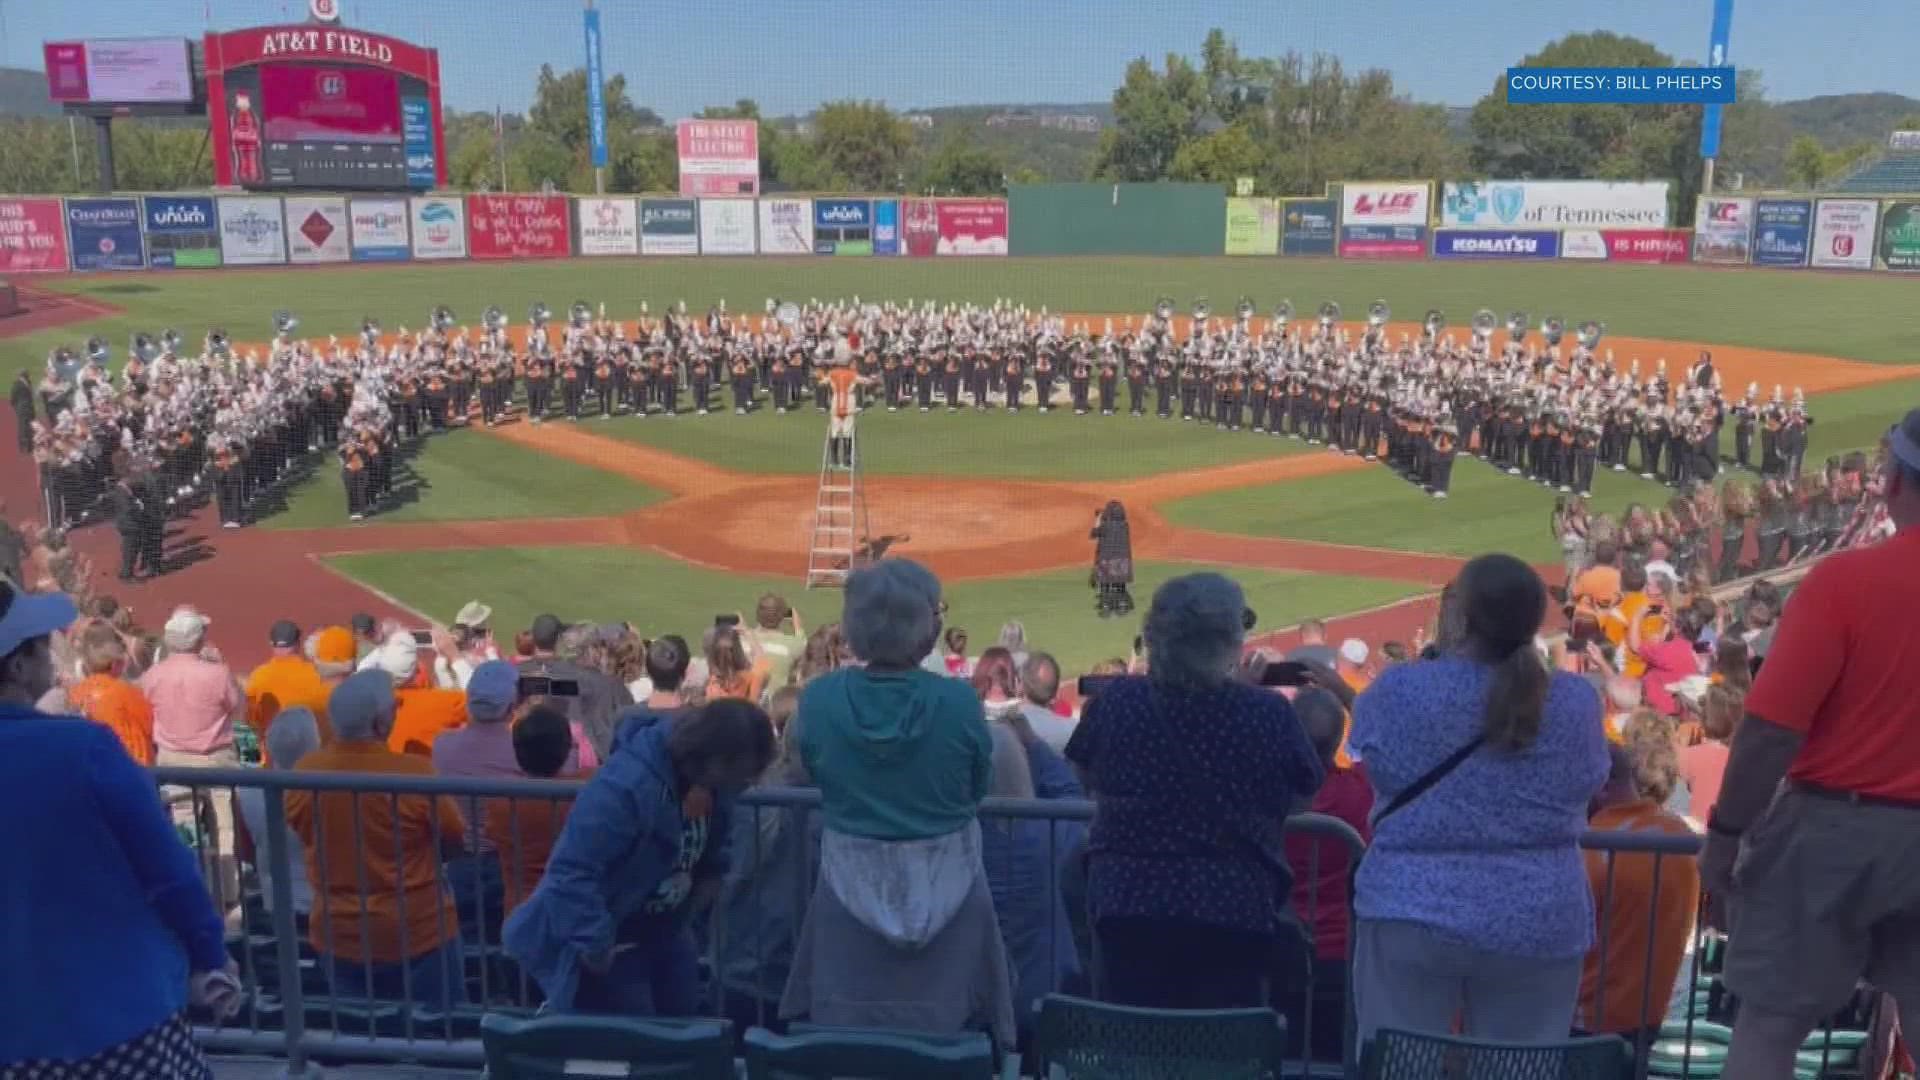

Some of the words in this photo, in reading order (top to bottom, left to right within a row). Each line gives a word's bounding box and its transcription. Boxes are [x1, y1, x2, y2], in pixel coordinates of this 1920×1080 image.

[263, 32, 318, 54] AT&T
[325, 31, 392, 62] FIELD
[690, 140, 745, 153] ELECTRIC
[1377, 192, 1418, 208] LEE
[1525, 205, 1545, 223] of
[1556, 204, 1660, 224] Tennessee
[1452, 238, 1537, 252] KOMATSU
[1613, 240, 1630, 251] IS
[1632, 239, 1684, 252] HIRING
